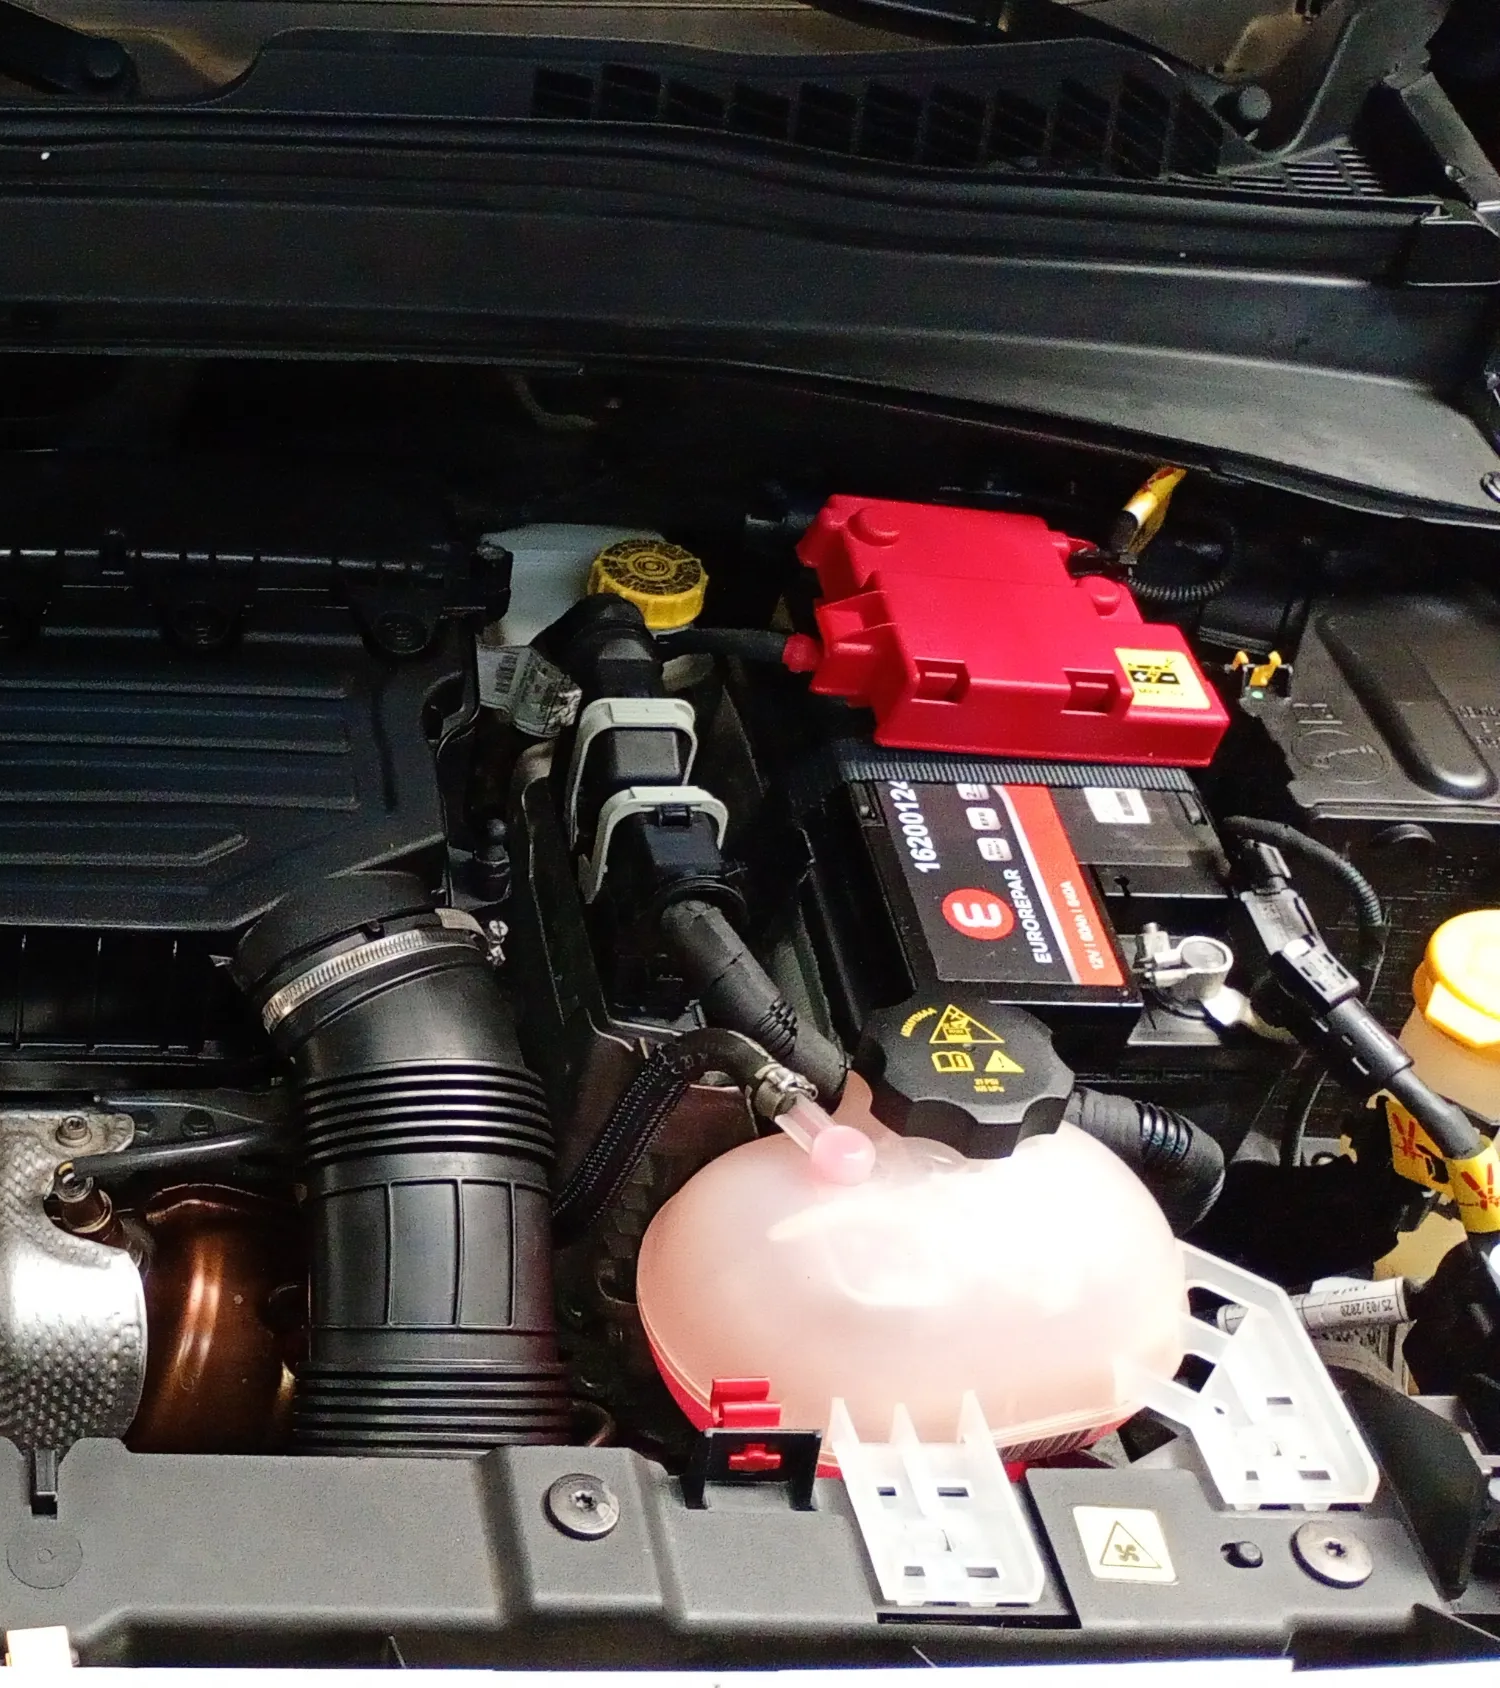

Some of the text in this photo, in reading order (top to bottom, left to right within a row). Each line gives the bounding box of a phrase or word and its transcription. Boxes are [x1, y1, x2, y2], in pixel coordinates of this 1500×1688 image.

[951, 902, 1002, 928] E
[1004, 868, 1053, 963] EUROREPAR
[1341, 1299, 1394, 1317] 25/03/2020
